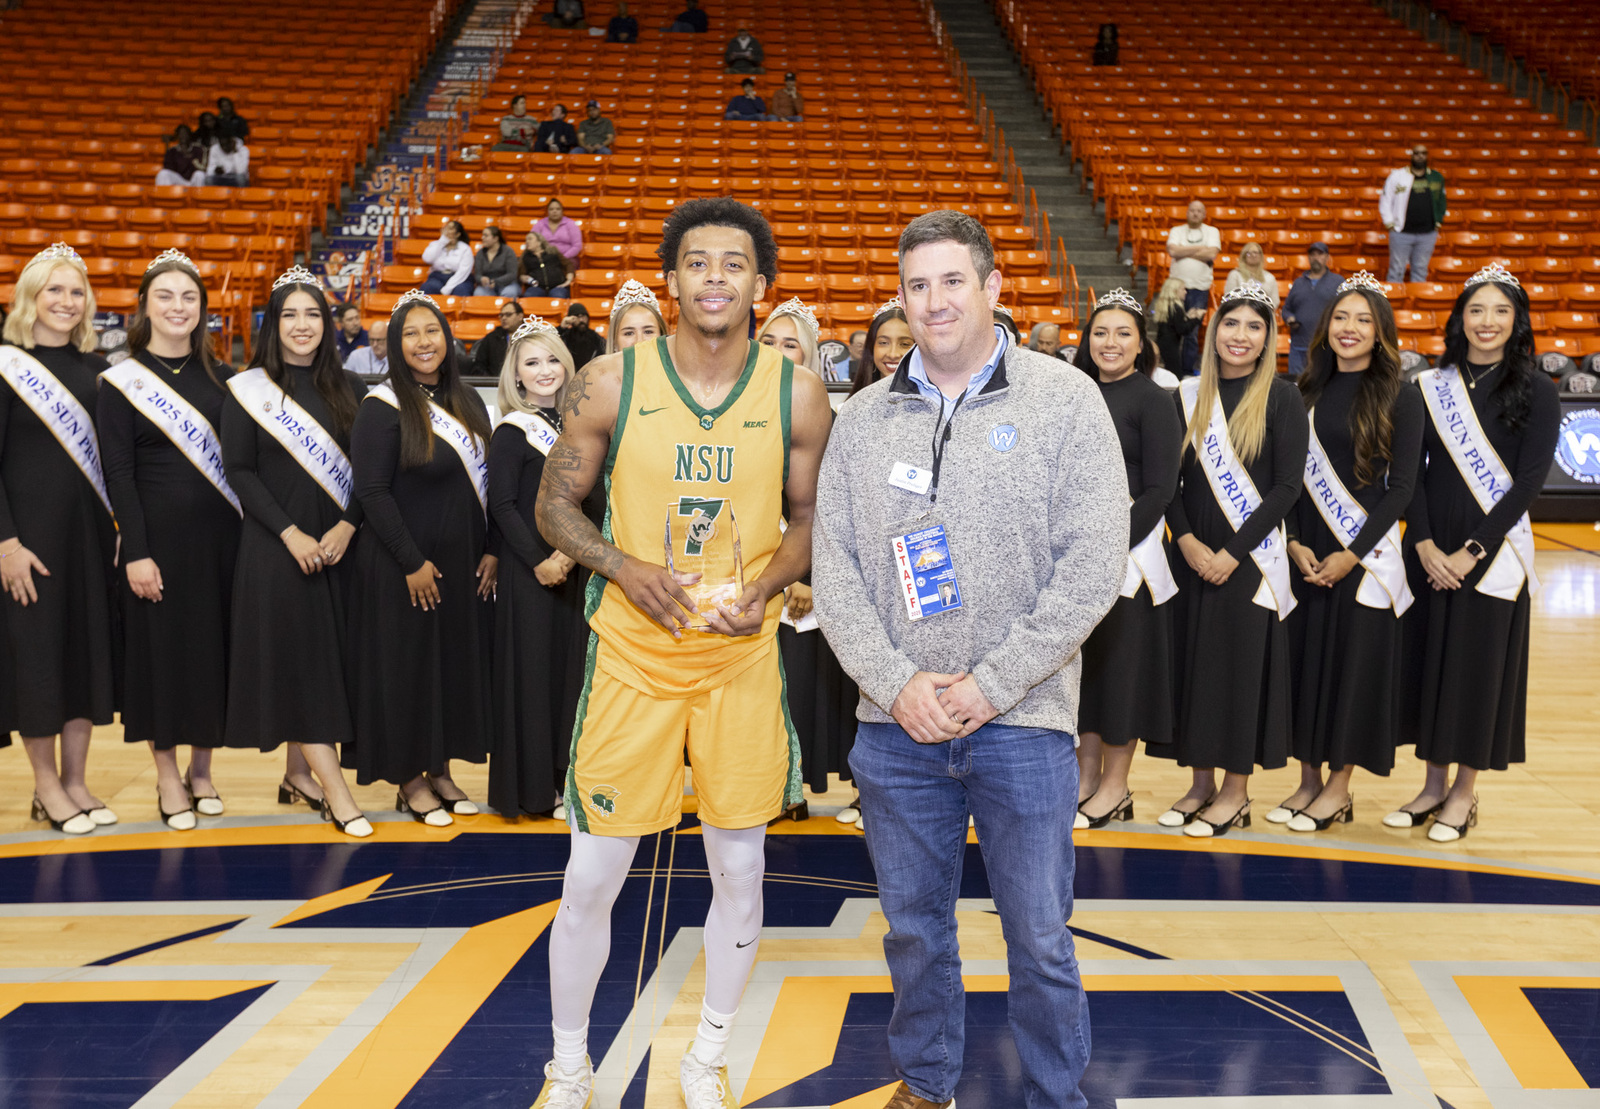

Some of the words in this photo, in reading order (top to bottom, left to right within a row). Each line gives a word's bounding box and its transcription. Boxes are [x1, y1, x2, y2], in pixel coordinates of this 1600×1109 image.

[19, 370, 53, 401] 2025
[51, 402, 83, 436] SUN
[147, 391, 181, 421] 2025
[179, 420, 211, 453] SUN
[743, 420, 768, 429] MEAC
[1435, 382, 1456, 411] 2025
[1446, 412, 1472, 446] SUN
[275, 410, 305, 437] 2025
[300, 435, 331, 466] SUN
[453, 430, 482, 460] SUN
[673, 443, 736, 484] NSU
[1204, 434, 1226, 469] SUN
[677, 496, 725, 557] 7
[1314, 478, 1361, 540] PRINCE
[895, 541, 917, 609] STAFF
